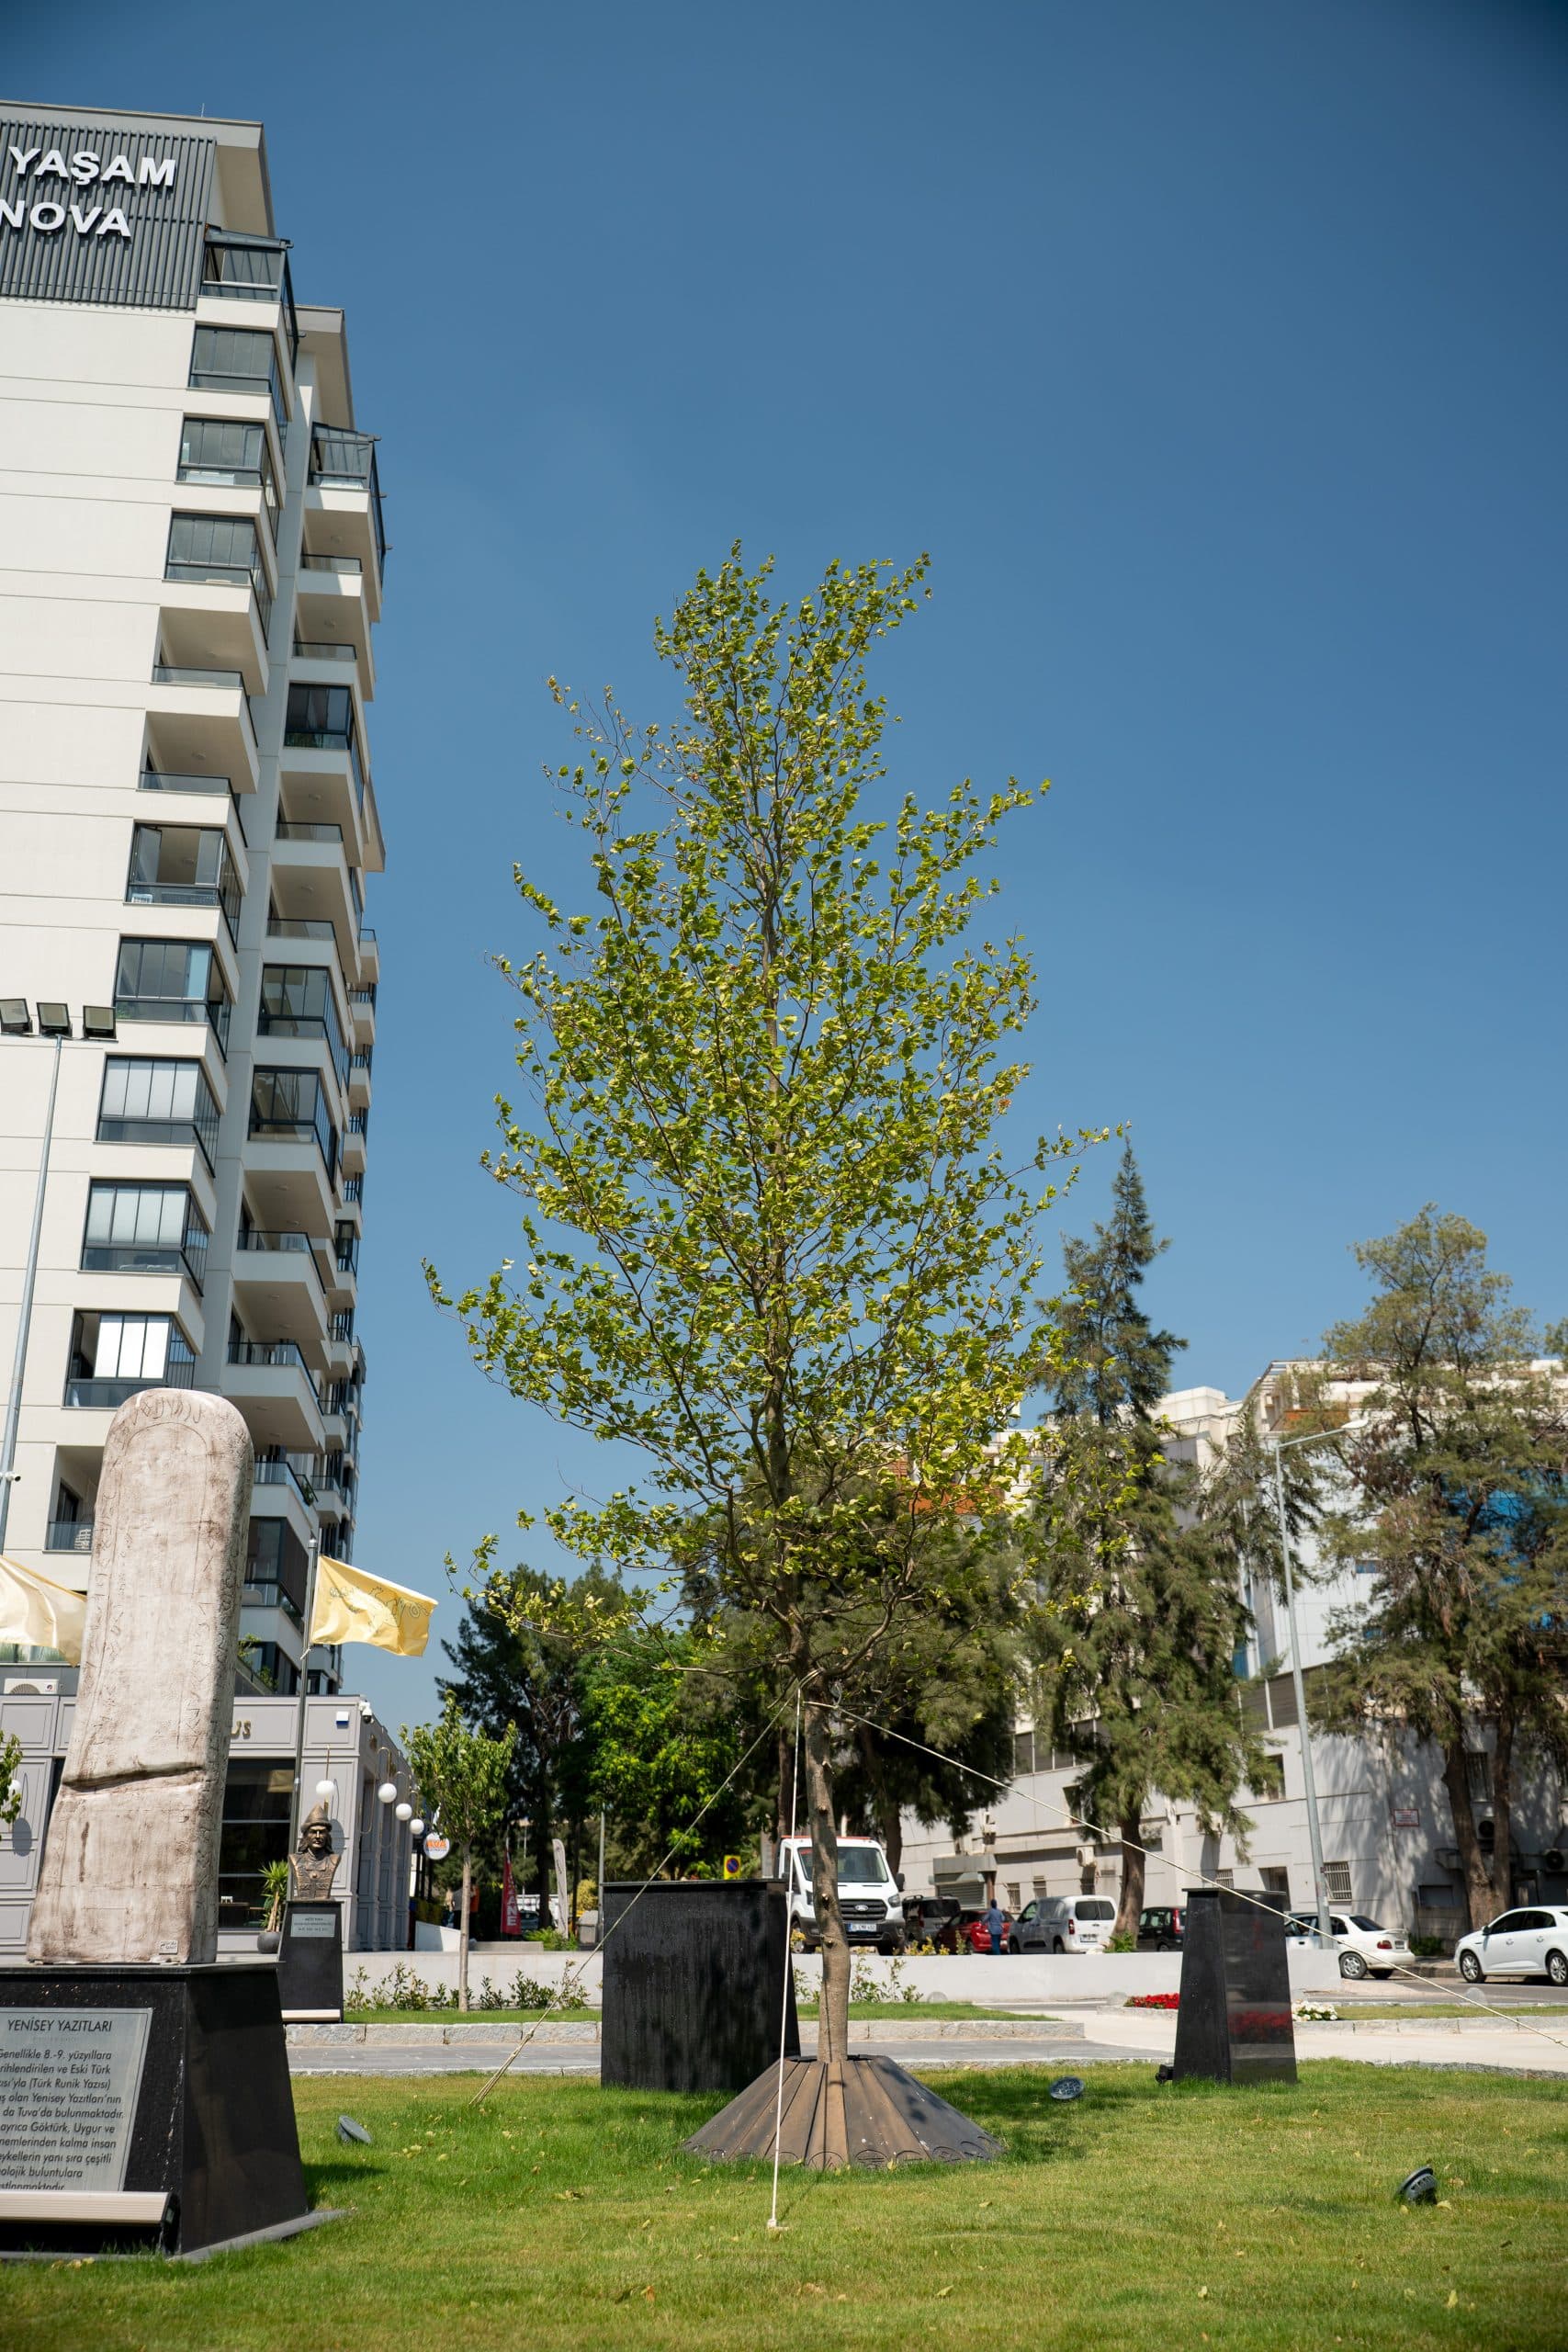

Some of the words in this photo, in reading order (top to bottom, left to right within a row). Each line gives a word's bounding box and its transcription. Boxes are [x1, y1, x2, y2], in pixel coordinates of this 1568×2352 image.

[8, 145, 176, 187] YAŞAM
[0, 198, 132, 238] NOVA
[7, 2017, 54, 2031] YENİSEY
[58, 2019, 113, 2032] YAZITLARI
[68, 2050, 112, 2062] yüzyıllara
[71, 2064, 88, 2074] Eski
[91, 2064, 111, 2075] Türk
[29, 2077, 51, 2090] (Türk
[55, 2078, 80, 2088] Runik
[84, 2079, 111, 2091] Yazısı)
[8, 2093, 28, 2102] olan
[32, 2093, 66, 2105] Yenisey
[69, 2093, 122, 2104] Yazıtları'nın
[3, 2106, 15, 2117] da
[18, 2107, 52, 2118] Tuva'da
[55, 2108, 124, 2119] bulunmaktadır.
[0, 2123, 28, 2133] ayrıca
[30, 2121, 71, 2133] Göktürk,
[73, 2122, 102, 2135] Uygur
[105, 2125, 116, 2133] ve
[60, 2137, 89, 2148] kalma
[91, 2138, 117, 2149] insan
[42, 2154, 63, 2165] yanı
[65, 2154, 83, 2164] sıra
[85, 2154, 113, 2166] çeşitli
[0, 2165, 26, 2178] olojik
[28, 2166, 84, 2177] buluntulara
